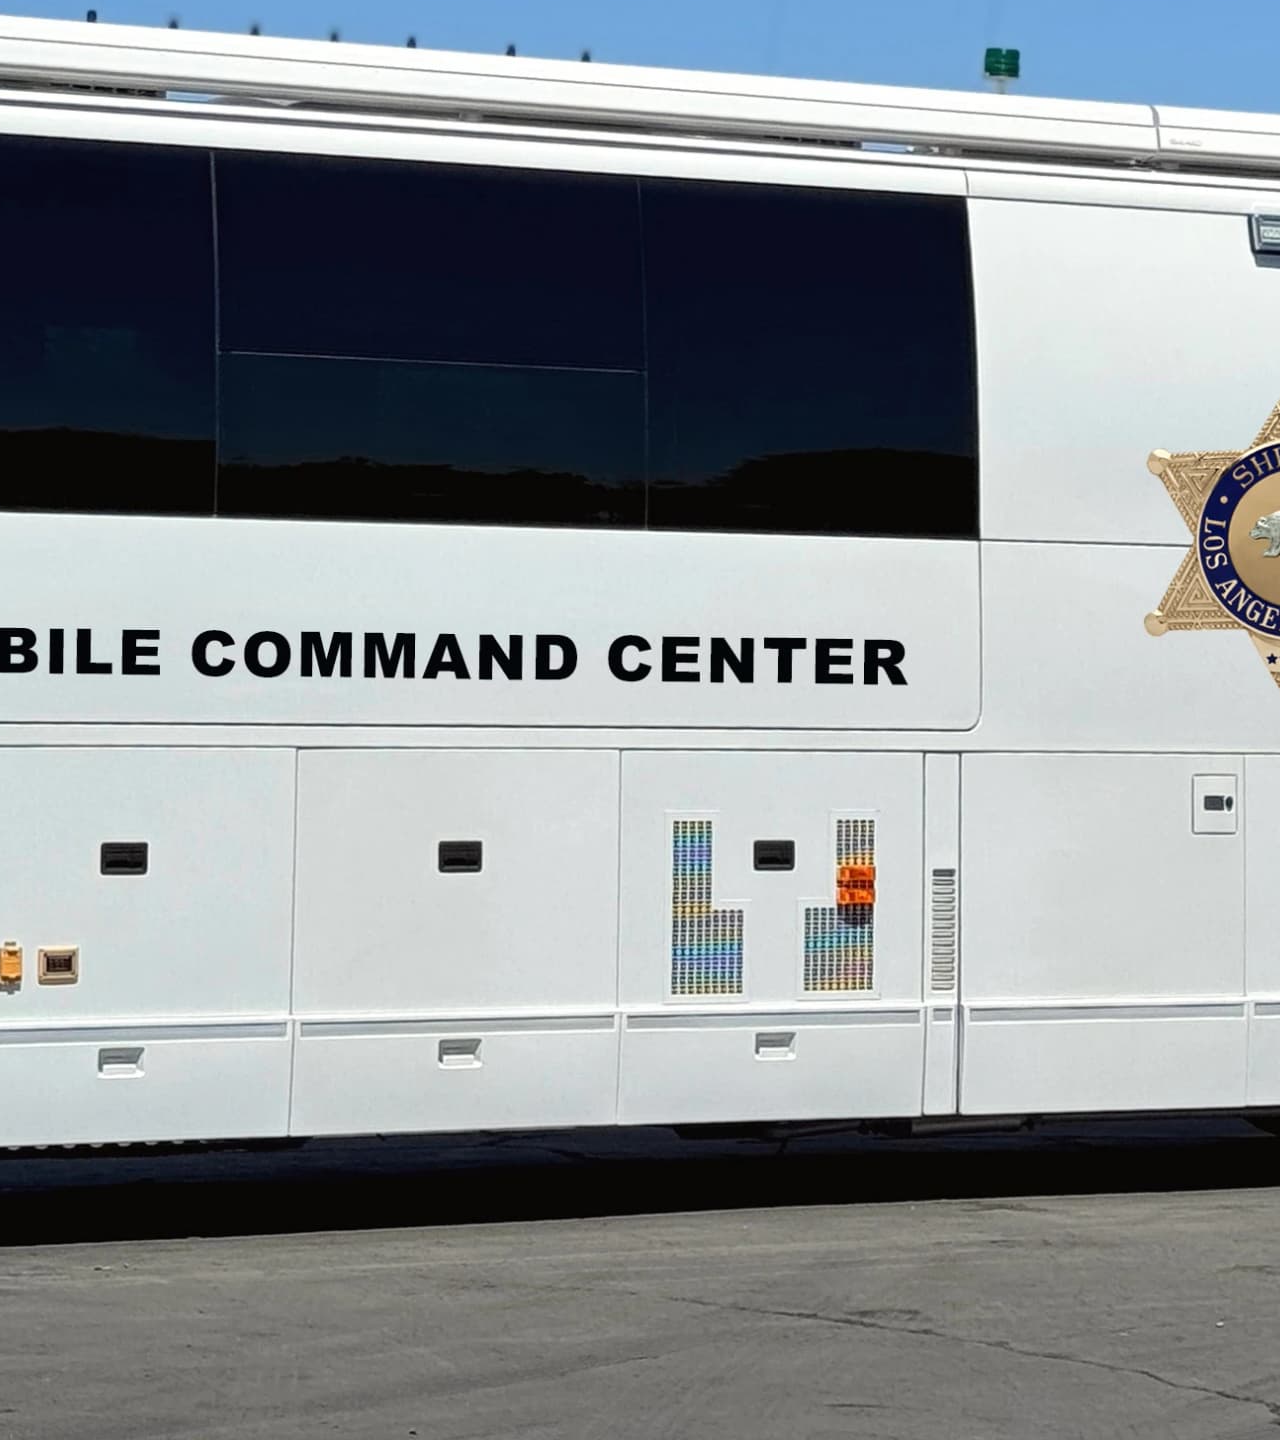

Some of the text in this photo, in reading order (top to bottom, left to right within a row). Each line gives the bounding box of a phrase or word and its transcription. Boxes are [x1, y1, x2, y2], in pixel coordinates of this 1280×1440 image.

[1203, 517, 1228, 570] LOS
[191, 629, 578, 681] COMMAND
[607, 634, 908, 686] CENTER
